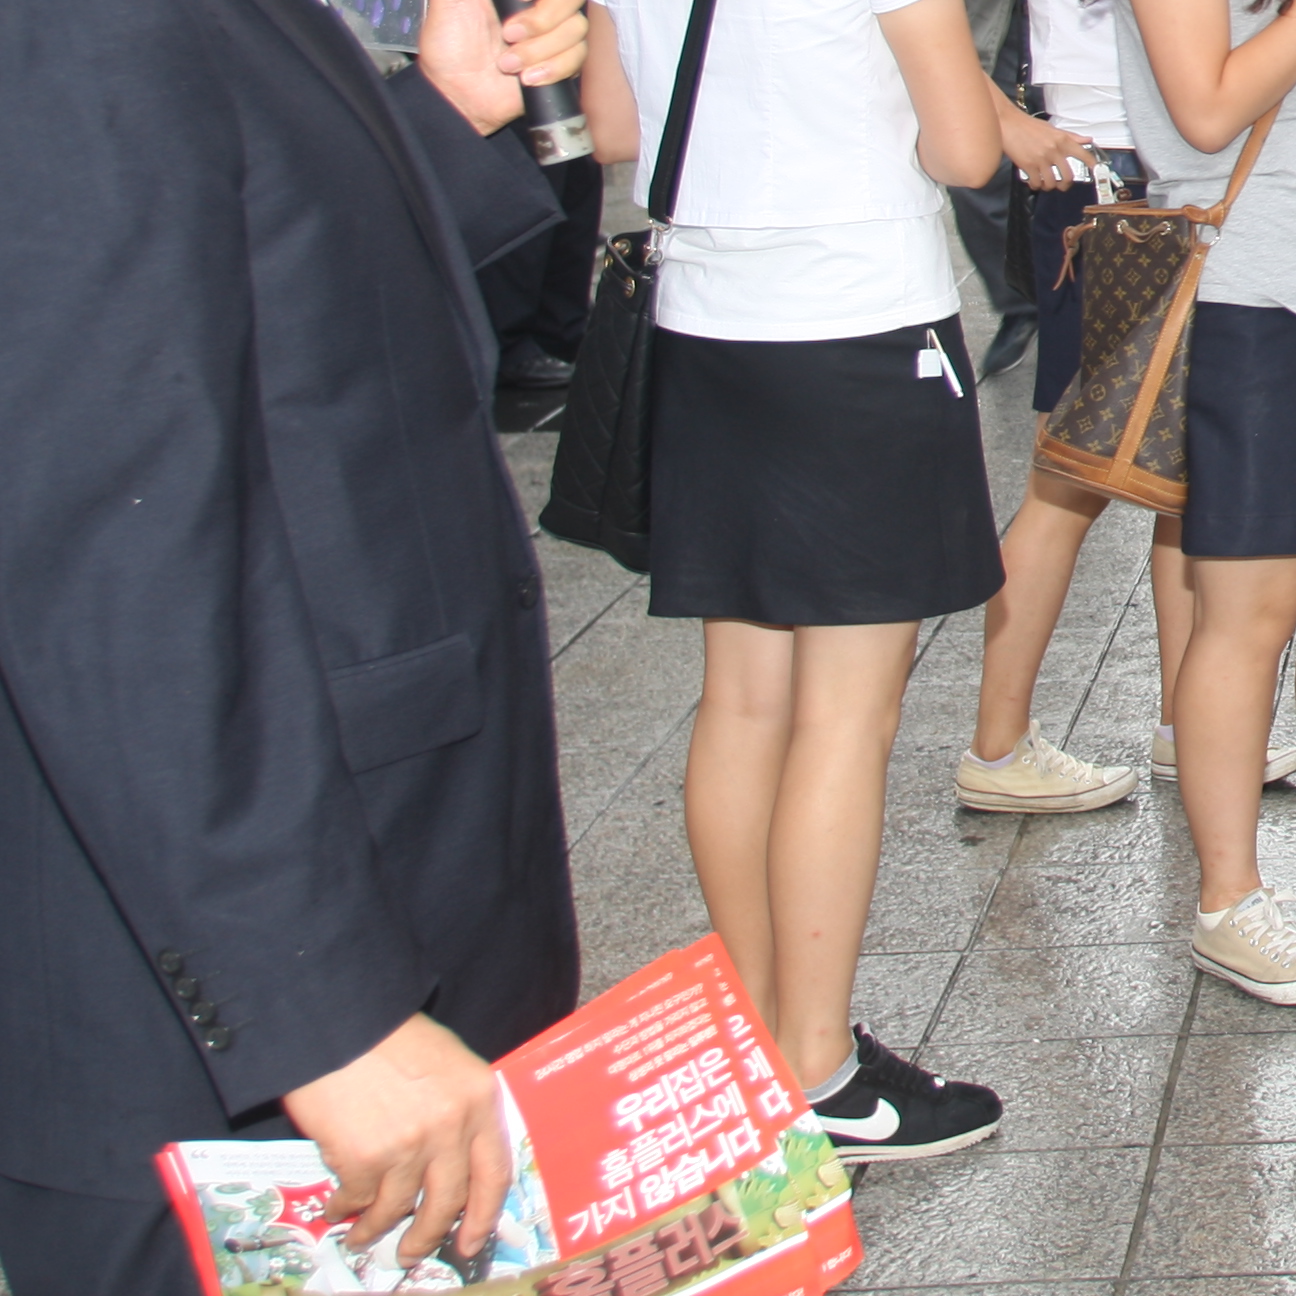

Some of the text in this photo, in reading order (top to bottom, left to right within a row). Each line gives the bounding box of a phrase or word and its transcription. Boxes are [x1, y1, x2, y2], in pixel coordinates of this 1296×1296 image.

[600, 1080, 748, 1190] 홈플러스에
[615, 1046, 734, 1133] 우리집은
[566, 1116, 762, 1241] 가지 않습니다
